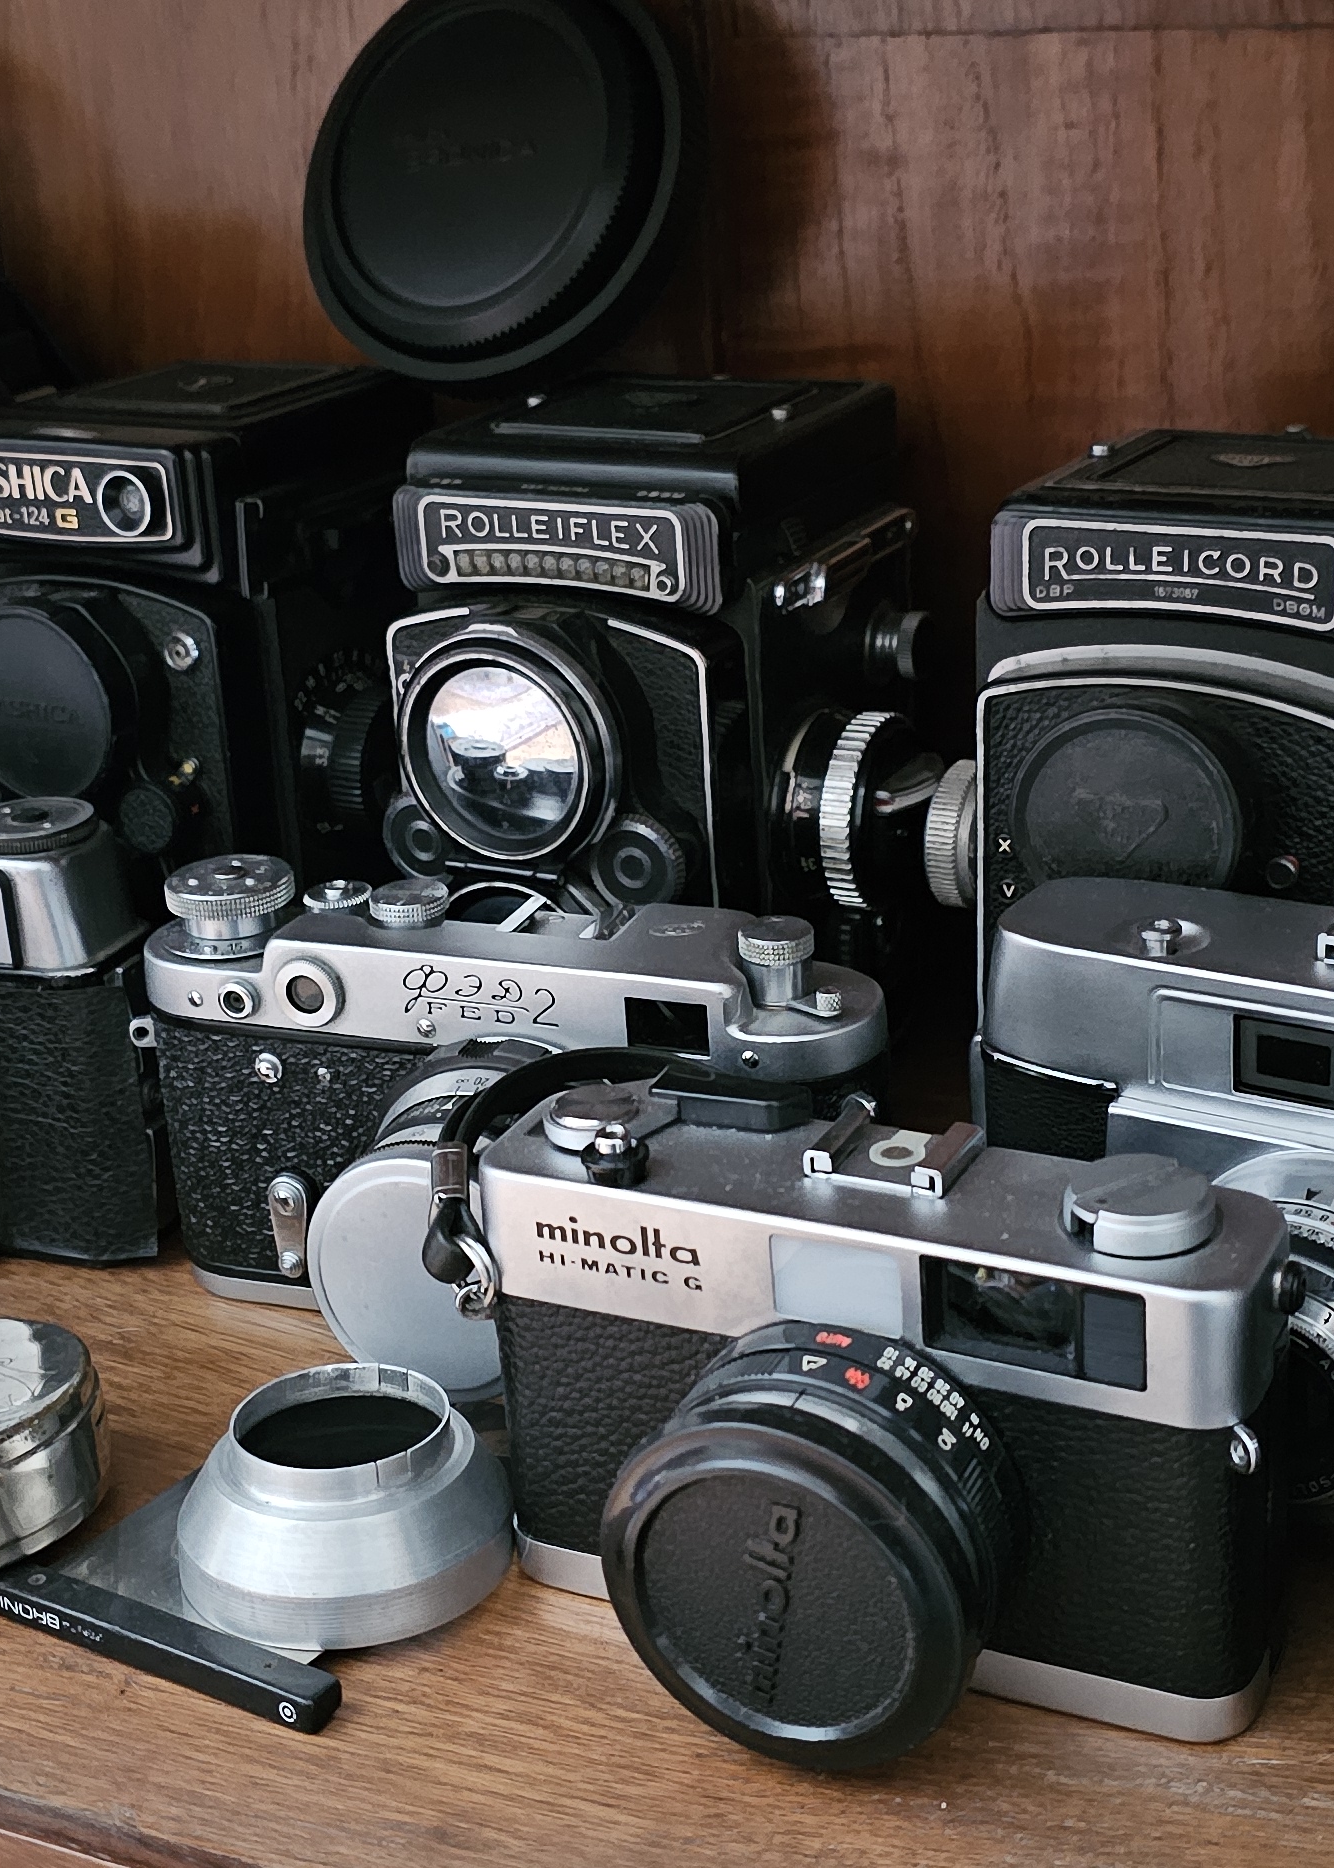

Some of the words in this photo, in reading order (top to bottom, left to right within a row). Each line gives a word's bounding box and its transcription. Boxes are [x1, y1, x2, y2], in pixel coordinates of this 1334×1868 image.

[55, 508, 79, 529] G
[440, 508, 660, 554] ROLLEIFLEX
[1043, 546, 1319, 589] ROLLEICORD
[1035, 584, 1075, 598] DBP
[1272, 598, 1326, 620] DBGM
[427, 1001, 516, 1025] FED
[532, 988, 560, 1027] 2
[536, 1216, 701, 1267] minolta
[539, 1250, 670, 1285] HI-MATIC
[684, 1276, 703, 1292] G
